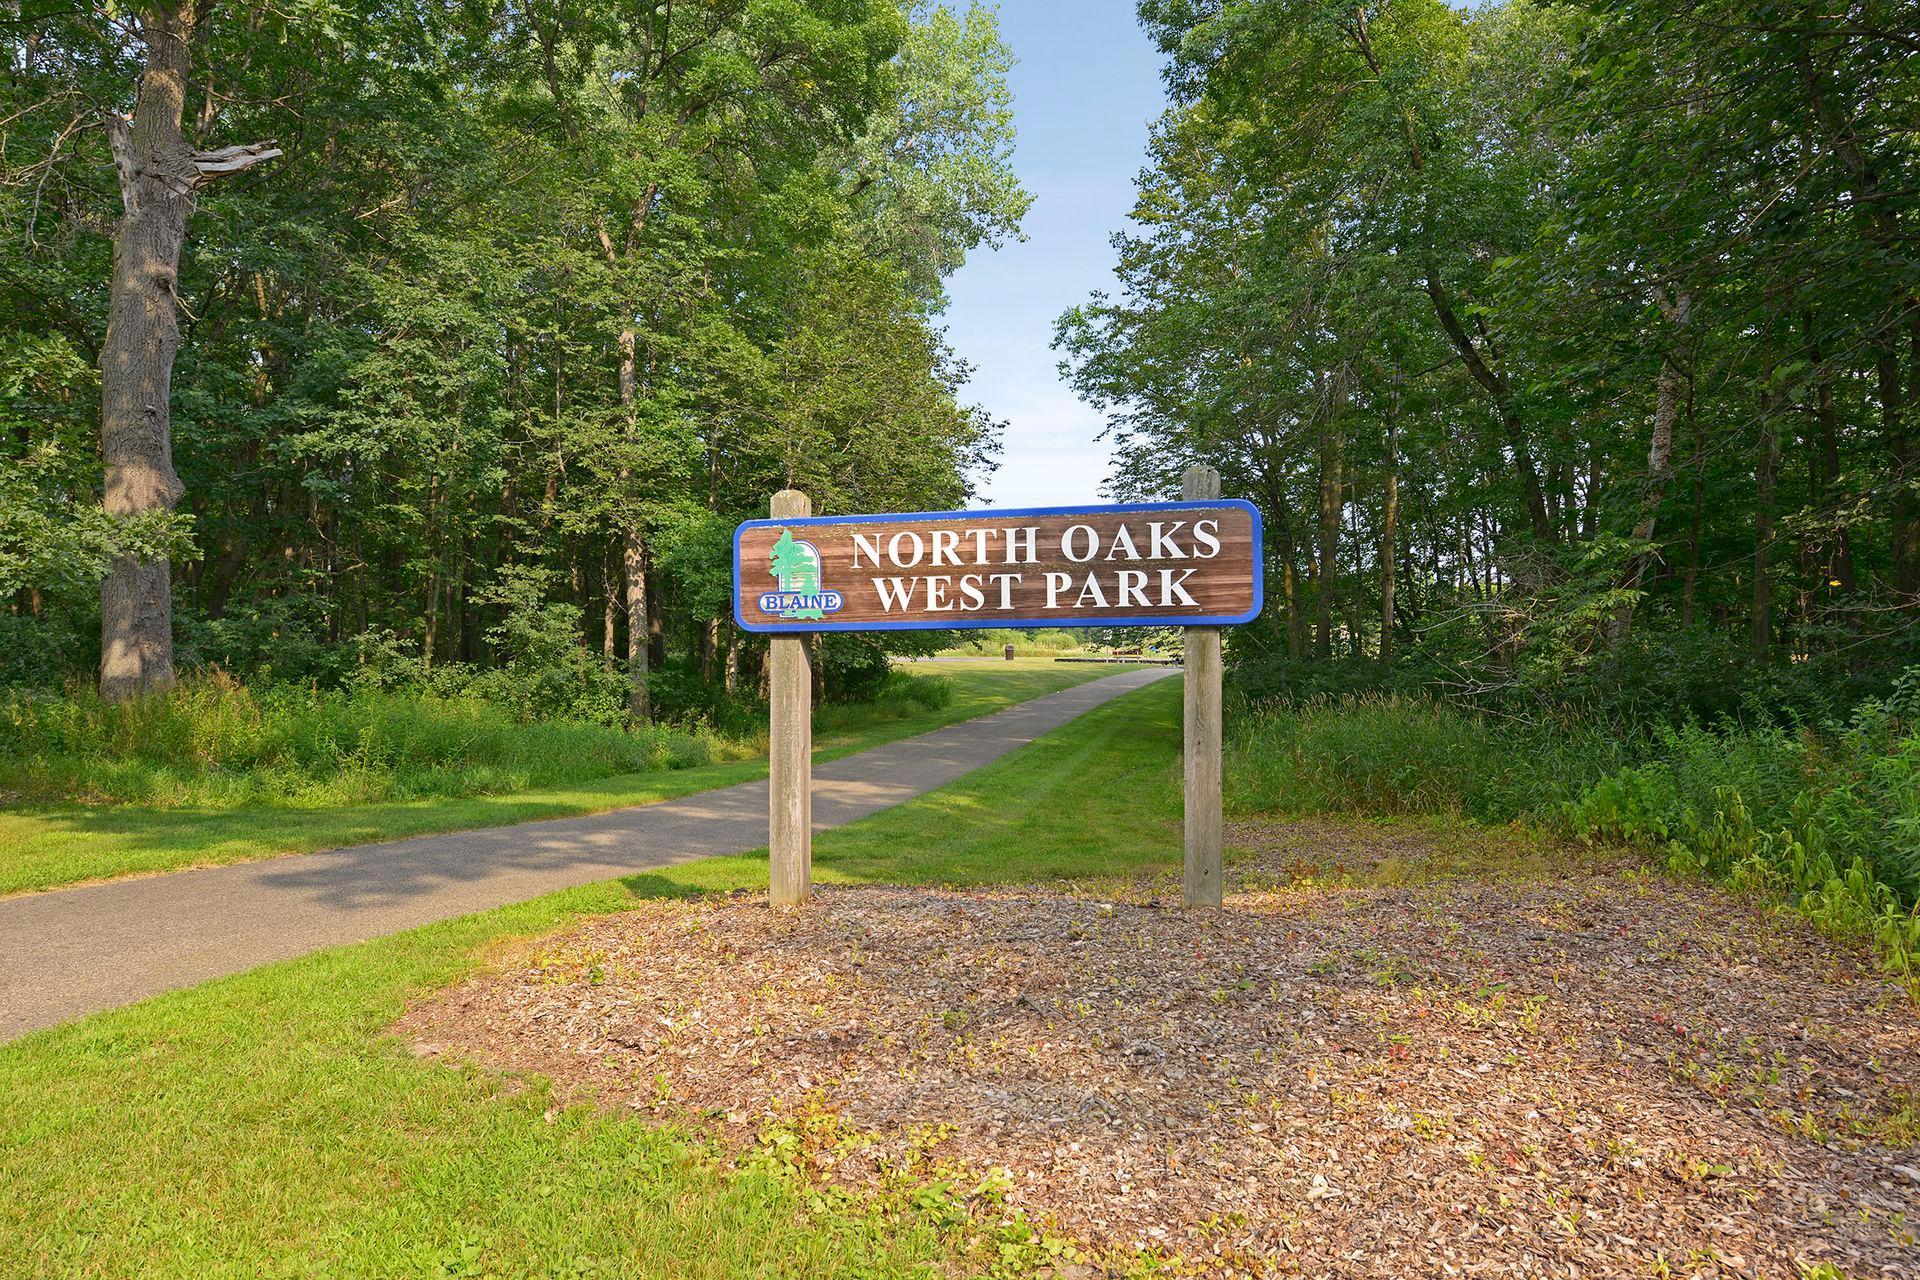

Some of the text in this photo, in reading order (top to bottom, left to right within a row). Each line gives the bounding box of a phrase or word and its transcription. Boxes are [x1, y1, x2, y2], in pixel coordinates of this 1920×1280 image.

[850, 519, 1221, 569] NORTH OAKS
[764, 594, 838, 610] BLAINE
[871, 568, 1200, 613] WEST PARK
